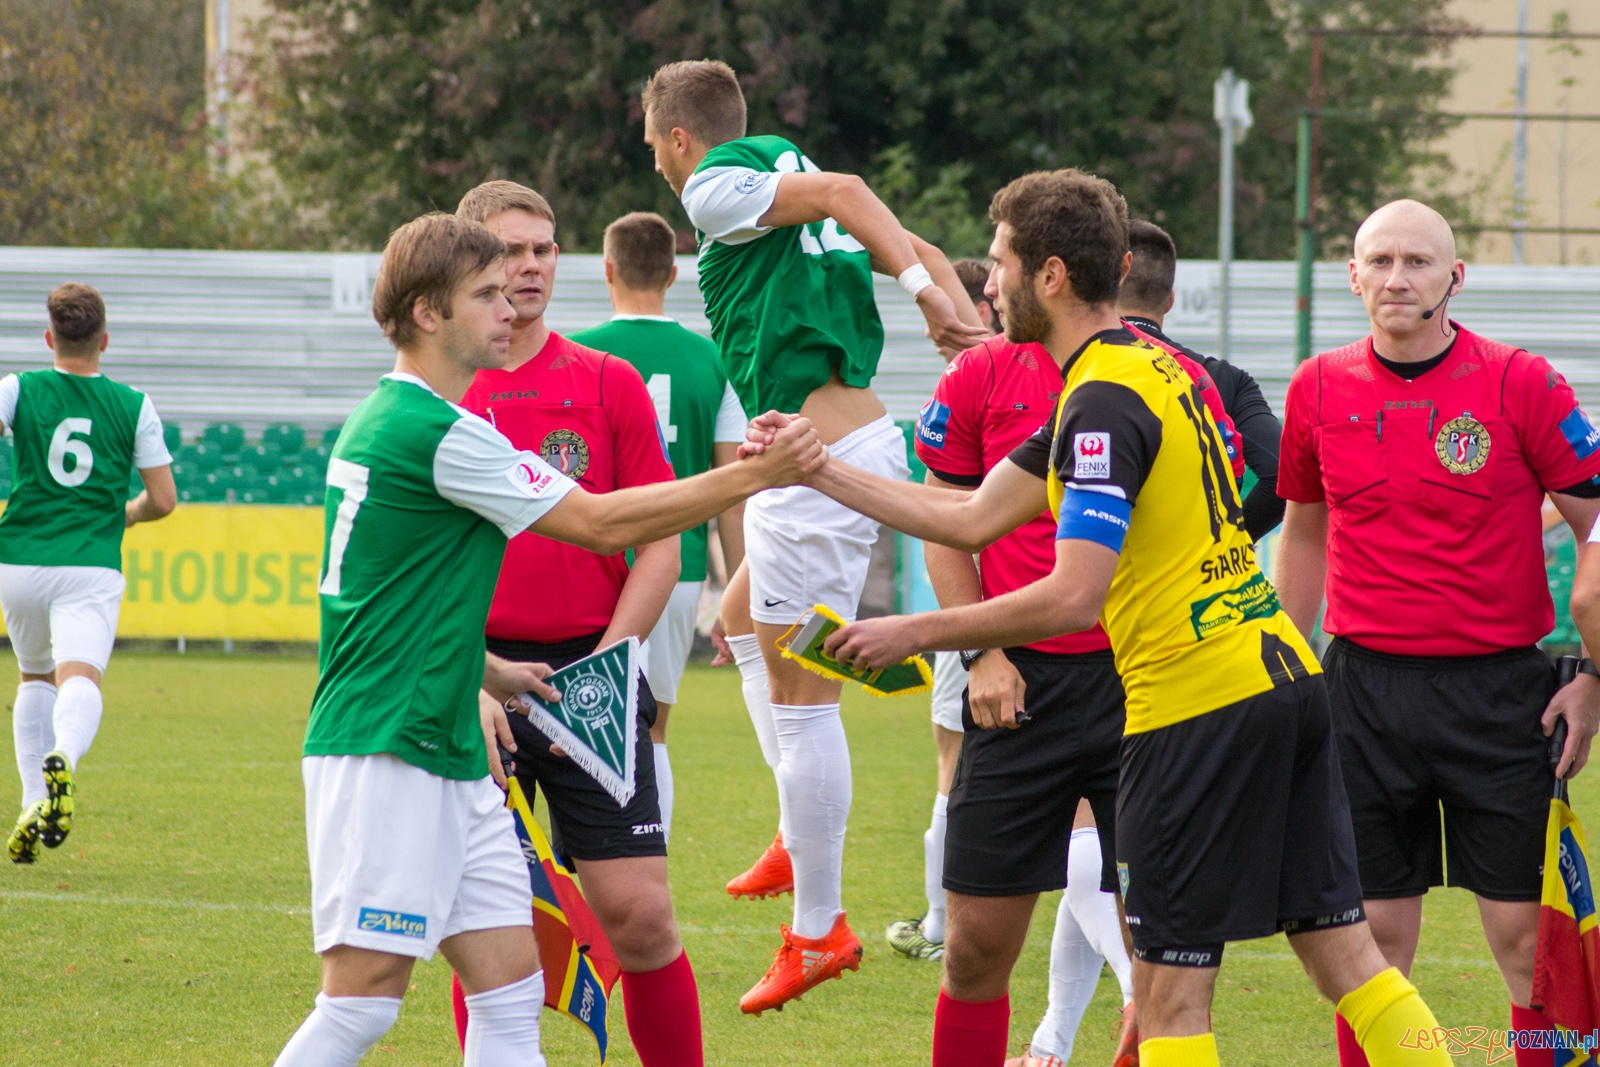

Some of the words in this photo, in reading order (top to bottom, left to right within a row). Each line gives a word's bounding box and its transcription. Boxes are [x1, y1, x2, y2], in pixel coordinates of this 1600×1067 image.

[489, 390, 538, 402] zina
[1382, 400, 1434, 410] zina
[920, 424, 944, 443] Nice
[47, 417, 93, 487] 6
[1077, 462, 1108, 472] FENIX
[127, 550, 317, 606] HOUSE
[361, 913, 425, 933] Astra
[804, 950, 835, 983] adidas
[1178, 951, 1211, 966] cep
[579, 979, 595, 1022] Nice
